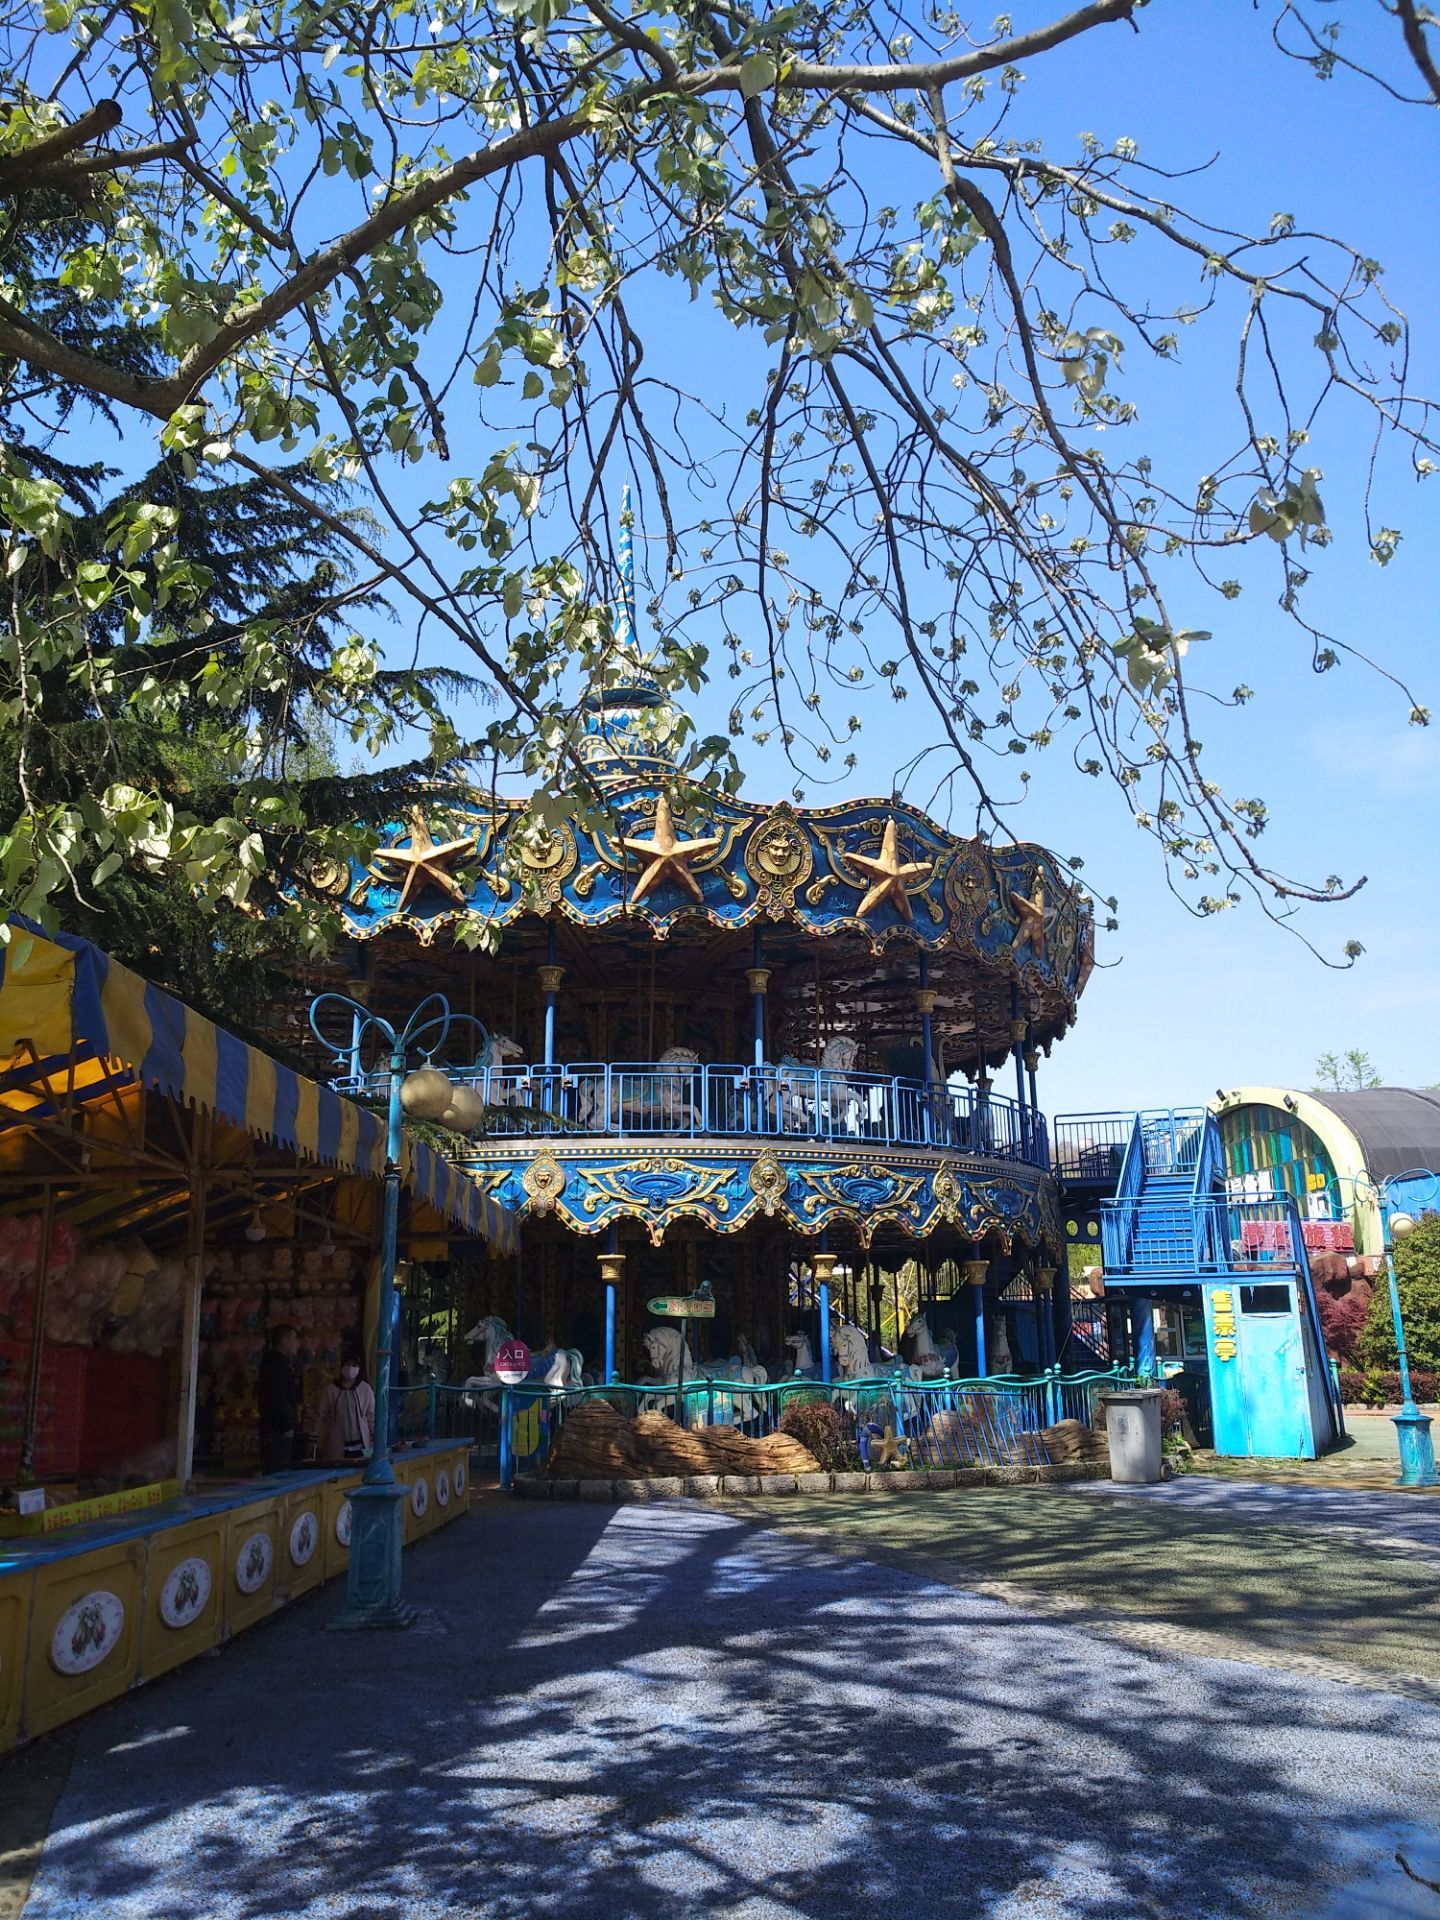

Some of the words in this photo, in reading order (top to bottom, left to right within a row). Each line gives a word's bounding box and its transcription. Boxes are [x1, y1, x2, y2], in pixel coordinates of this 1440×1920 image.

[1210, 1289, 1237, 1362] 售票亭
[502, 1348, 524, 1361] 入口
